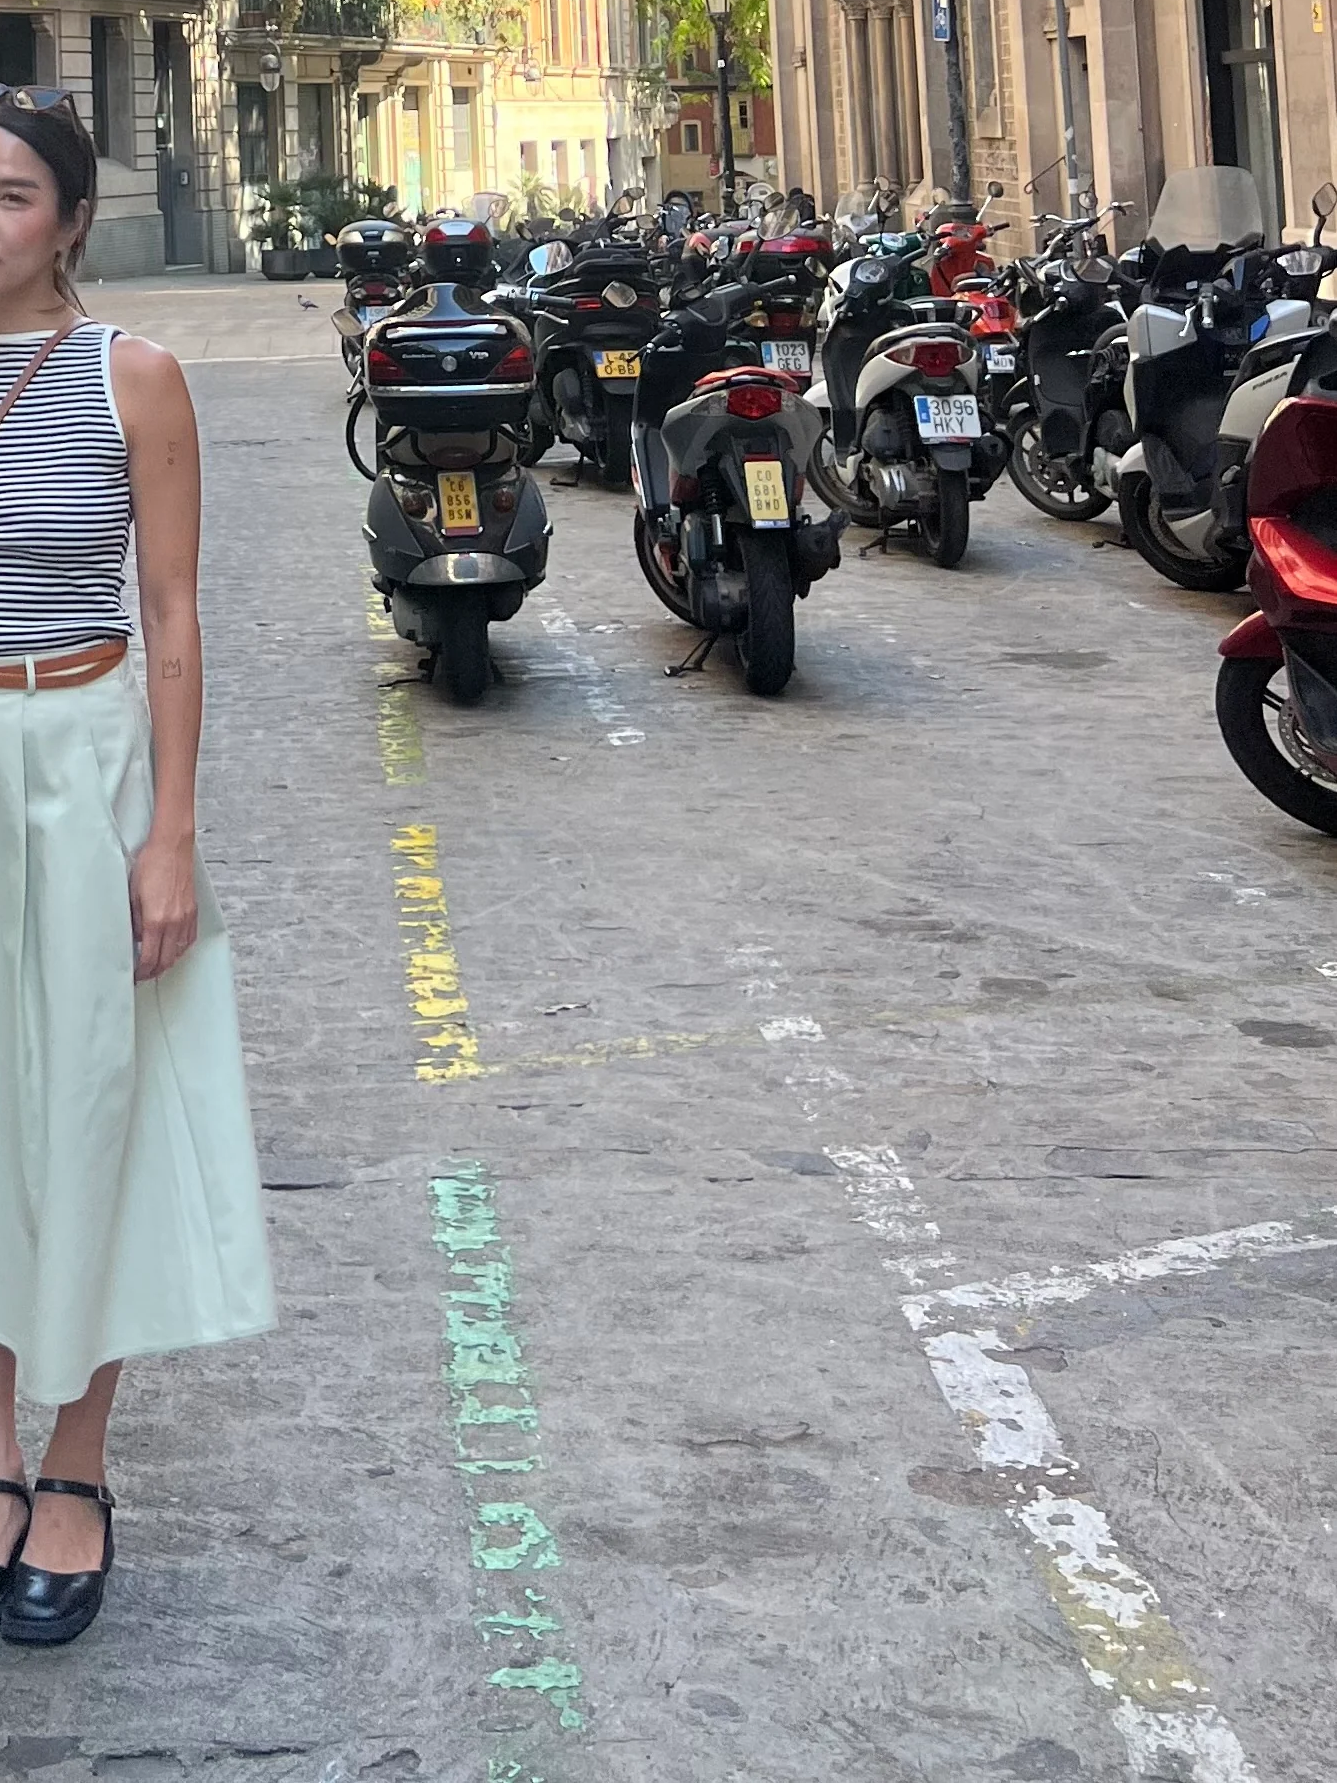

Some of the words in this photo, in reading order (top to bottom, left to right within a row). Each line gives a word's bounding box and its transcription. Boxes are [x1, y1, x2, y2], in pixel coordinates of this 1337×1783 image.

[775, 343, 806, 356] 1023
[930, 399, 974, 416] 3096
[933, 417, 965, 434] HKY
